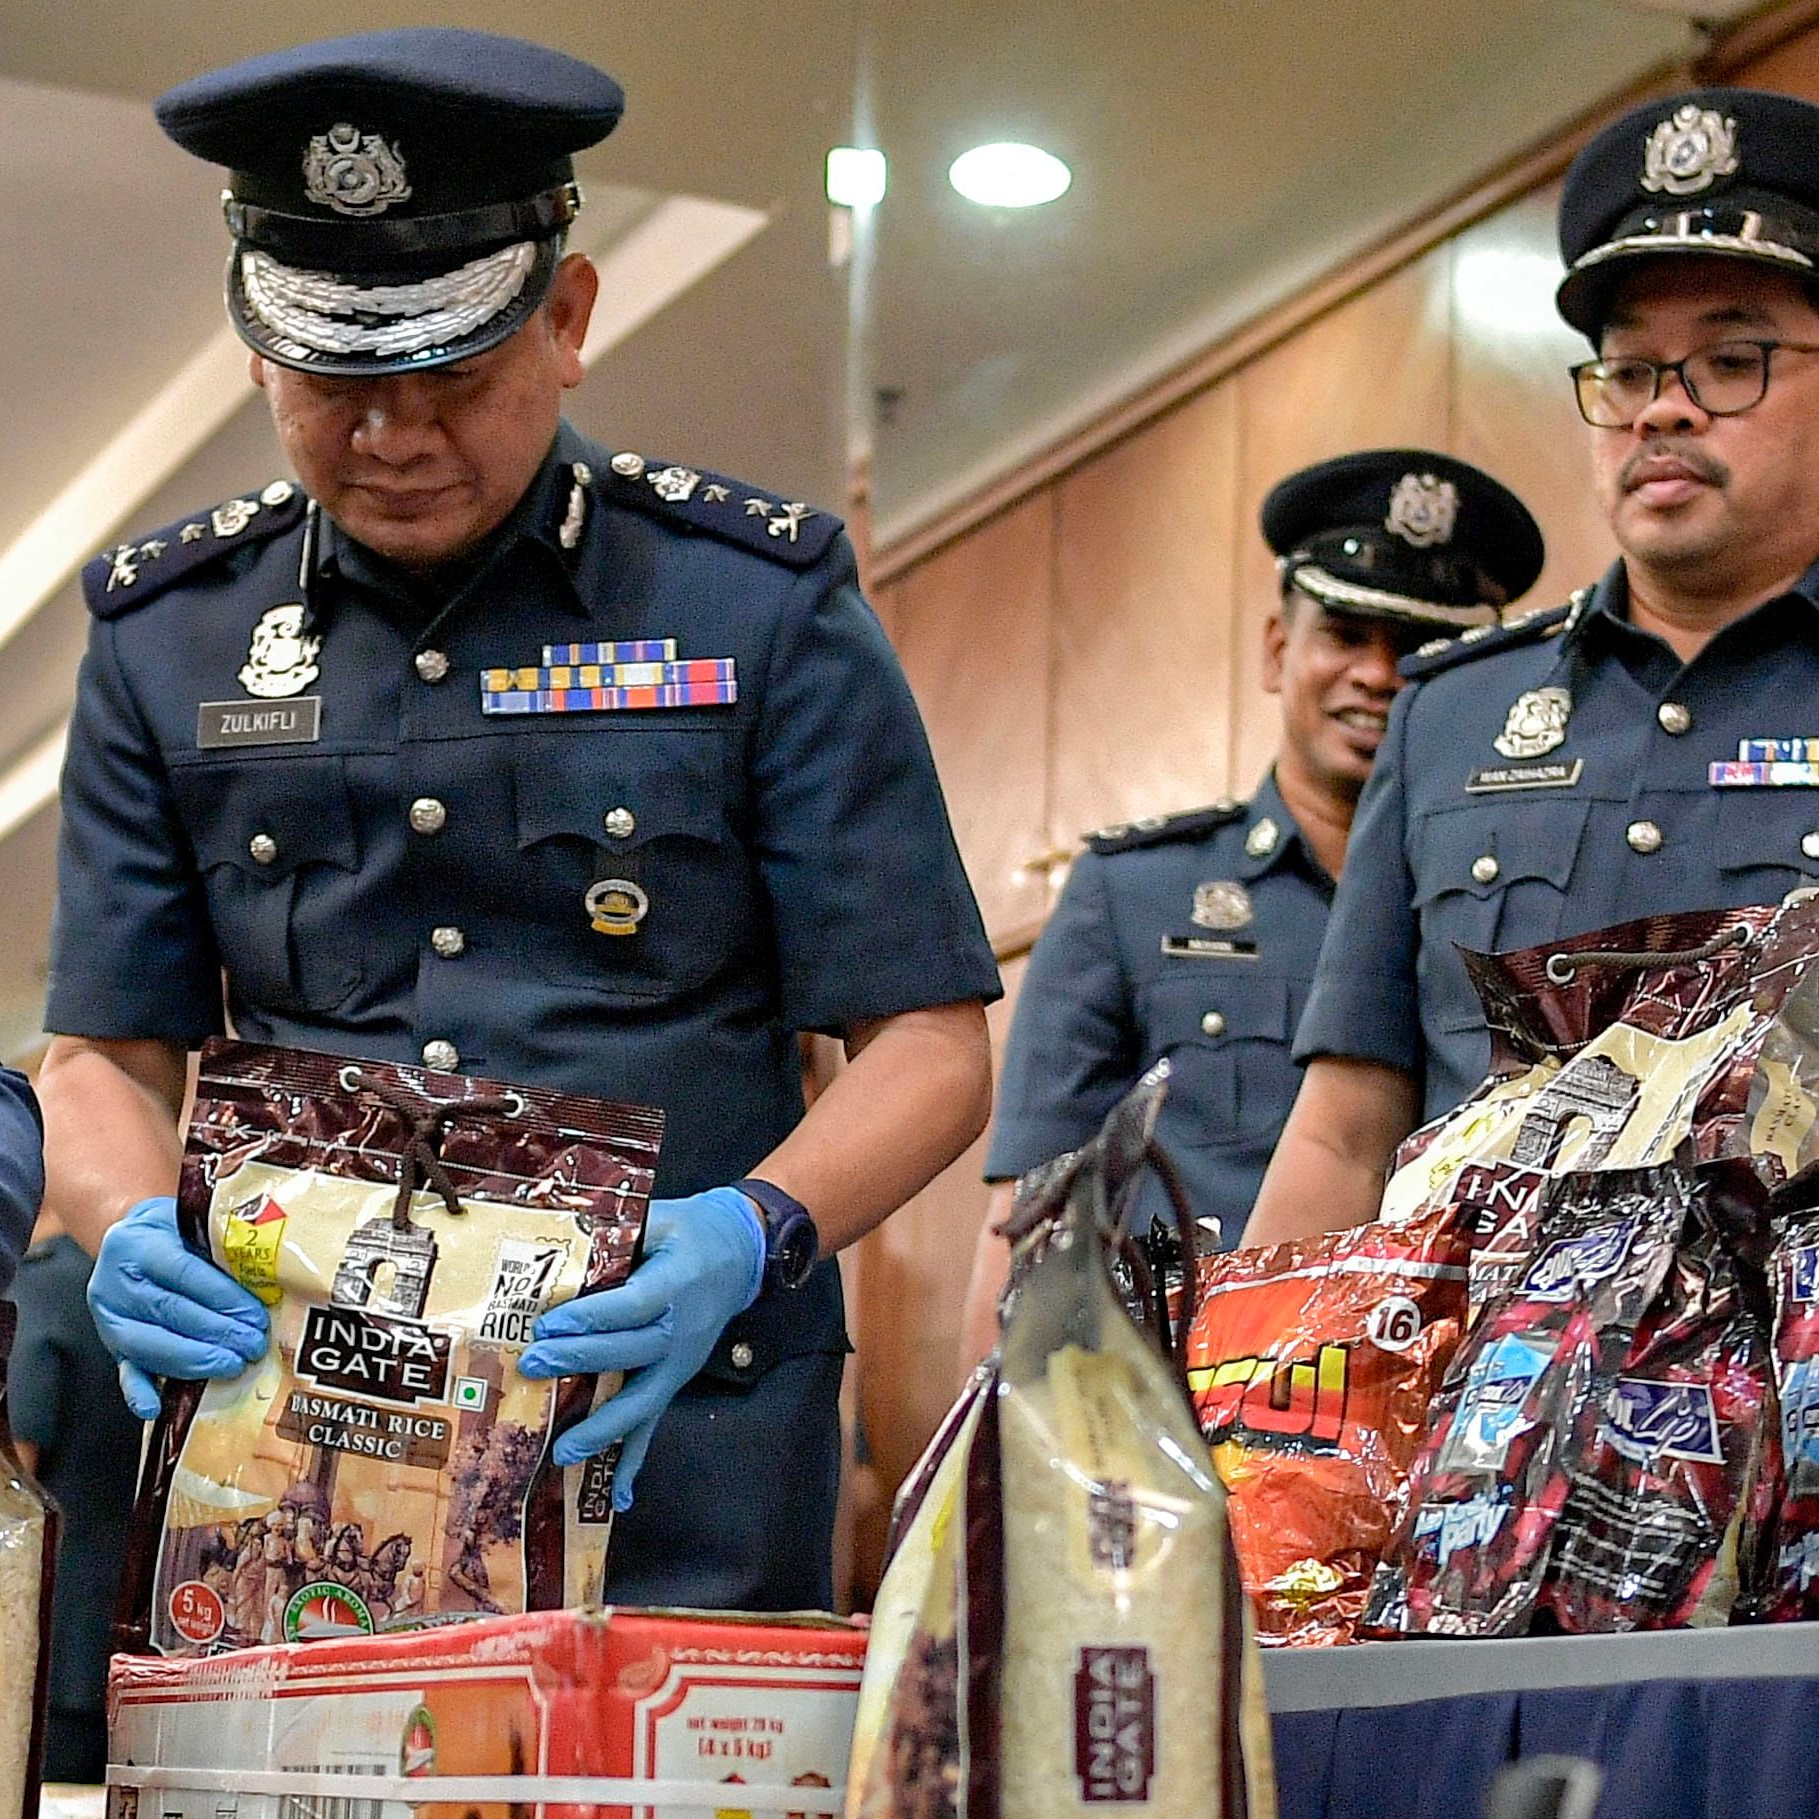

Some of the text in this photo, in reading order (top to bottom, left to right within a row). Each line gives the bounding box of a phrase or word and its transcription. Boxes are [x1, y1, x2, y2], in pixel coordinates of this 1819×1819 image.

[221, 711, 295, 734] ZULKIFLI
[245, 1229, 259, 1247] 2
[314, 1316, 439, 1362] INDIA
[480, 1312, 532, 1343] RICE
[1375, 1306, 1415, 1343] 16
[310, 1346, 431, 1390] GATE
[291, 1395, 445, 1440] BASMATI RICE
[309, 1424, 402, 1458] CLASSIC
[182, 1589, 213, 1621] 5 kg
[335, 1588, 369, 1629] AROMA
[1089, 1655, 1116, 1796] INDIA
